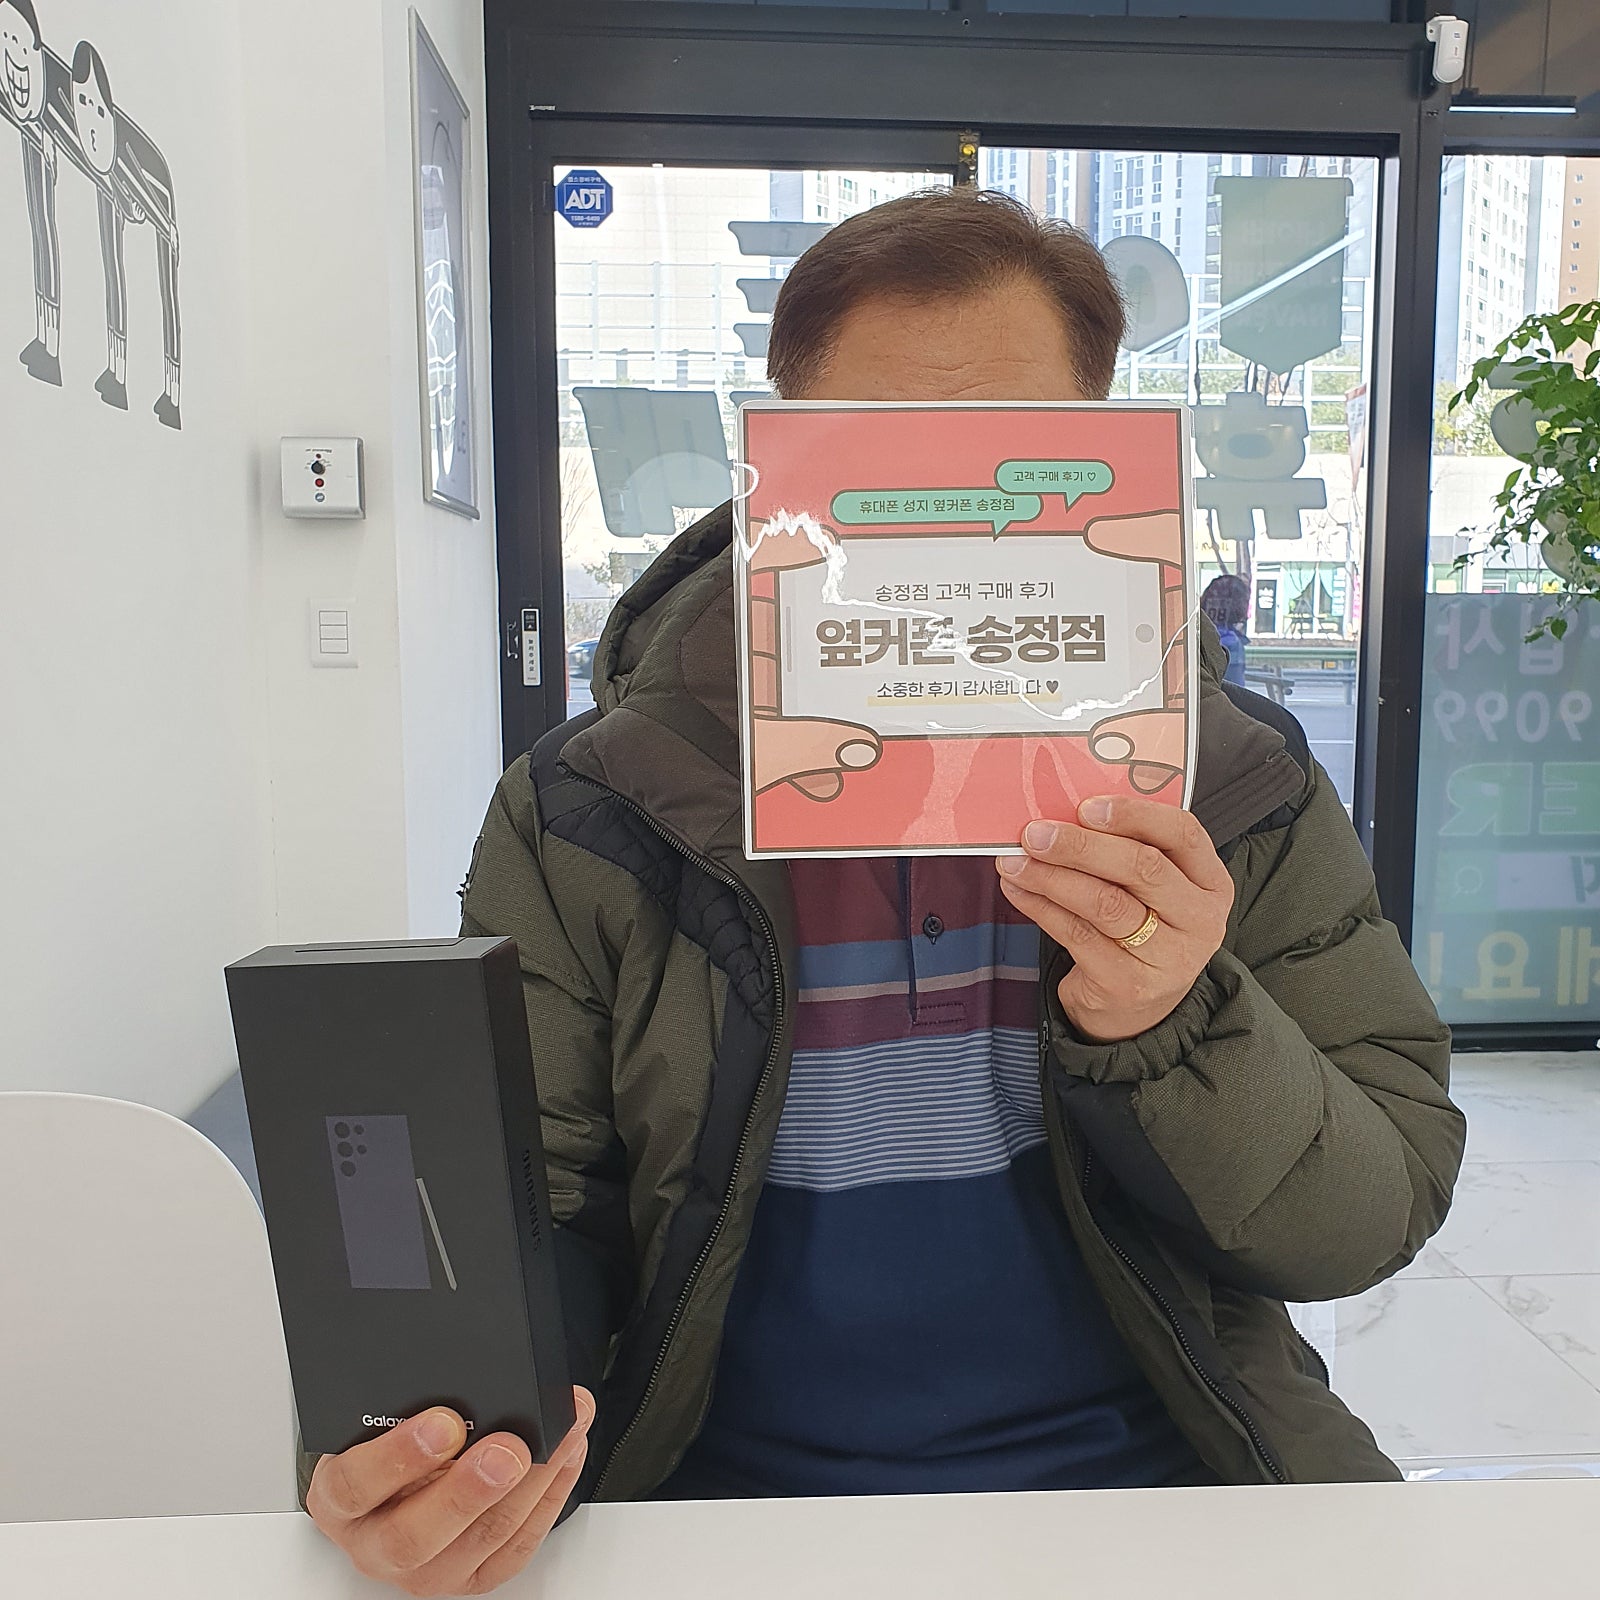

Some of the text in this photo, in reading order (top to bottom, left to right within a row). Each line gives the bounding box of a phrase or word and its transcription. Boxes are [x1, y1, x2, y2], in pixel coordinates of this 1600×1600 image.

[565, 188, 605, 210] ADT
[1013, 470, 1084, 483] 고객 구매 후기
[859, 497, 1016, 514] 휴대폰 성지 옆커폰 송정점
[875, 581, 1055, 602] 송정점 고객 구매 후기
[967, 614, 1107, 664] 송정점
[876, 680, 1042, 699] 소중한 후기 감사합니다
[521, 1148, 542, 1252] SAMSUNG
[362, 1414, 407, 1428] Galax
